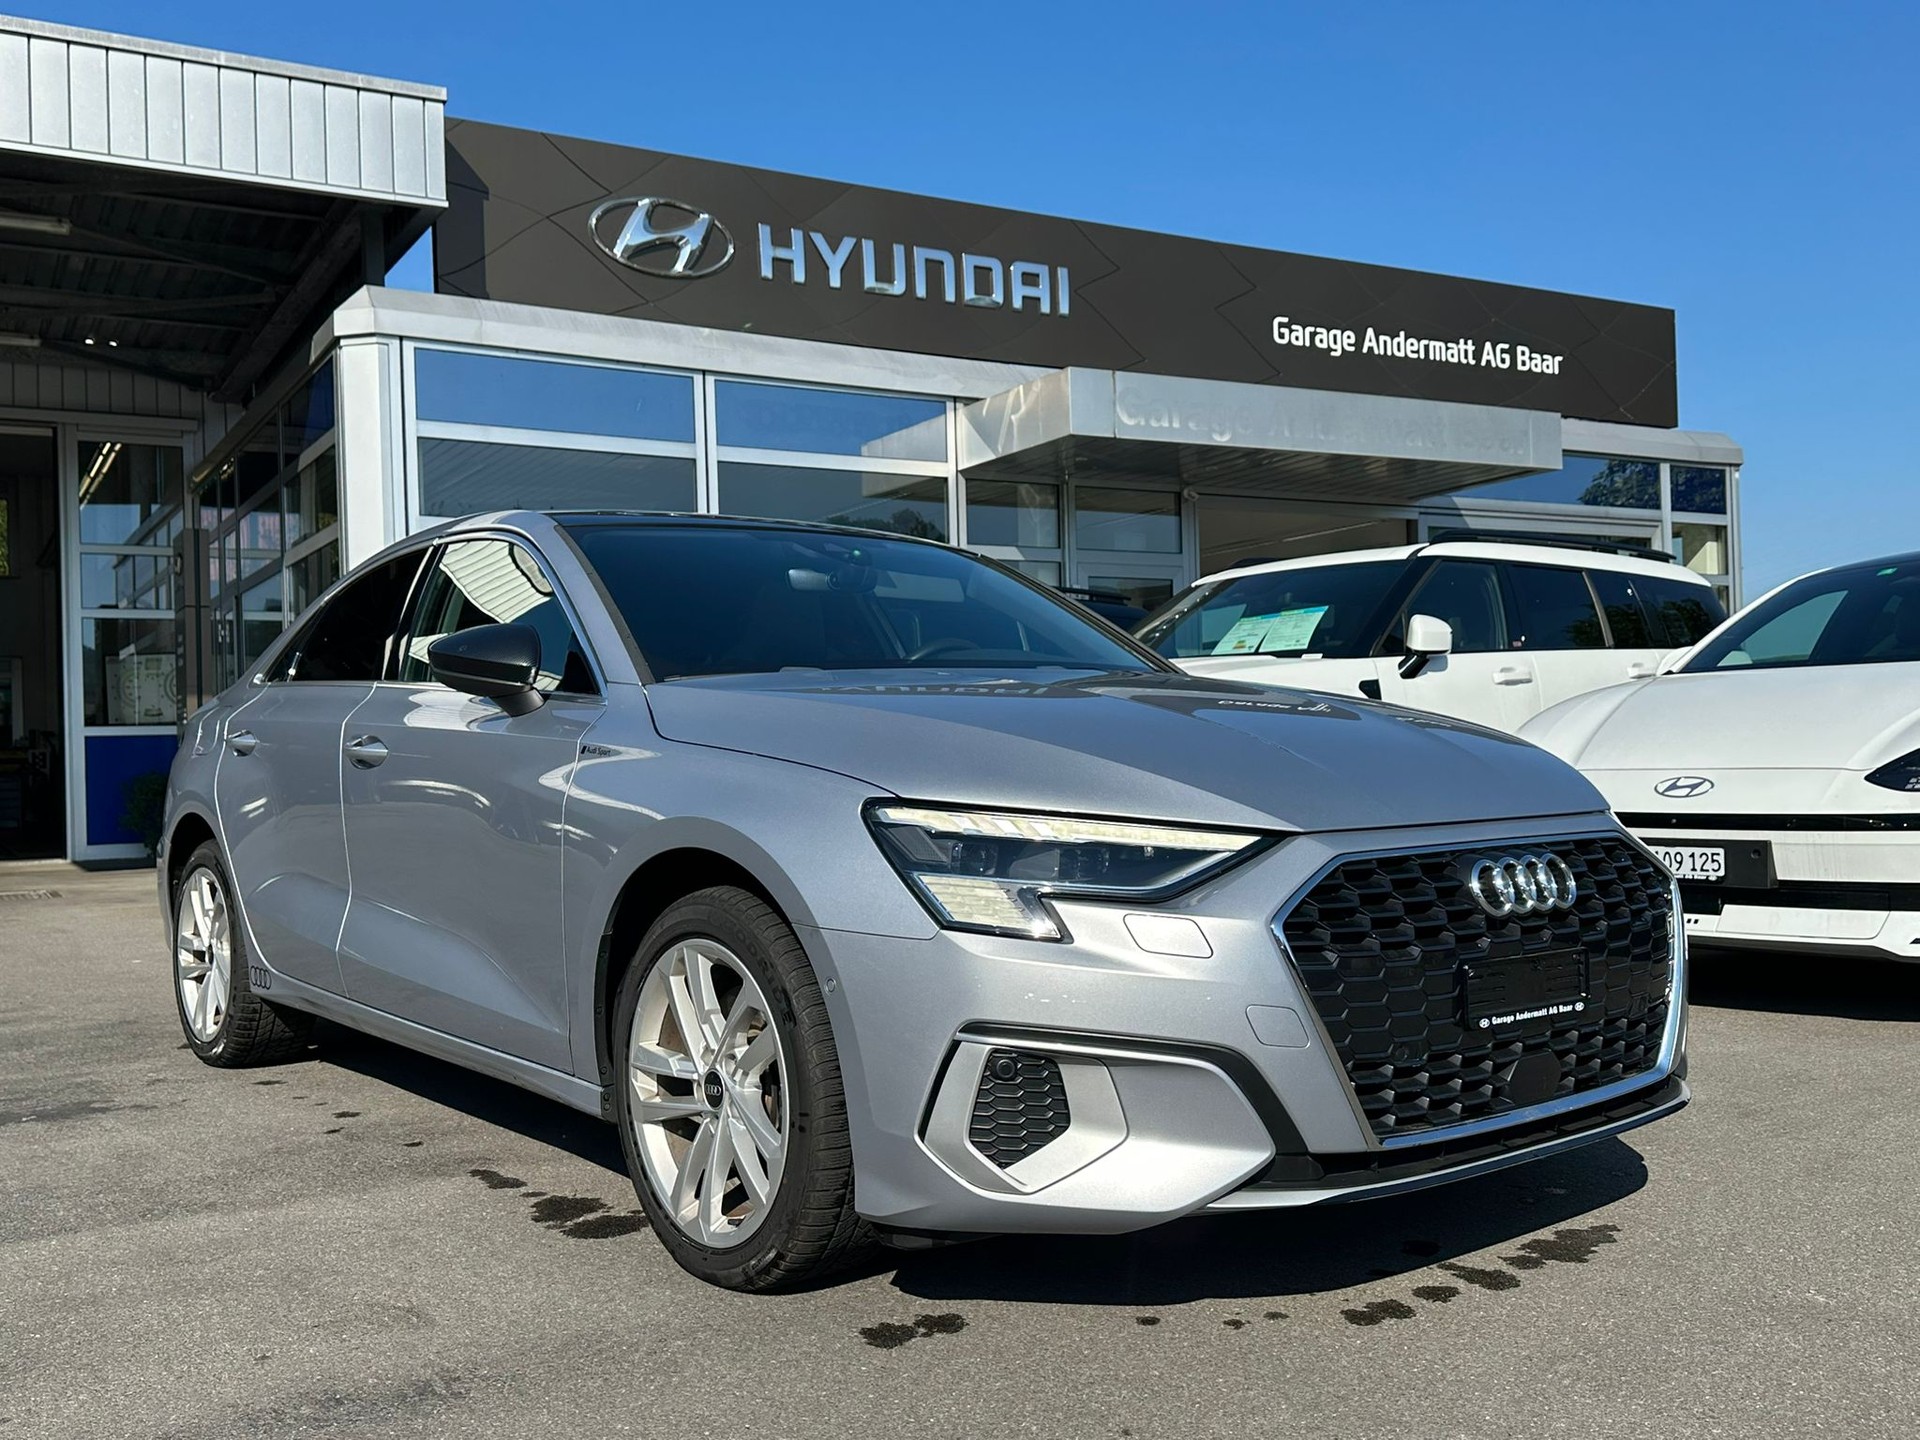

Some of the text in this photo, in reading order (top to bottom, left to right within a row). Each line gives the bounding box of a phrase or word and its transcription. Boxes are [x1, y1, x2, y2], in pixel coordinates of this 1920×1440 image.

[758, 222, 1070, 316] HYUNDAI
[1272, 316, 1564, 375] Garage Andermatt AG Baar
[1655, 851, 1721, 872] 09 125
[1492, 1005, 1573, 1025] Garage Andermatt AG Baar
